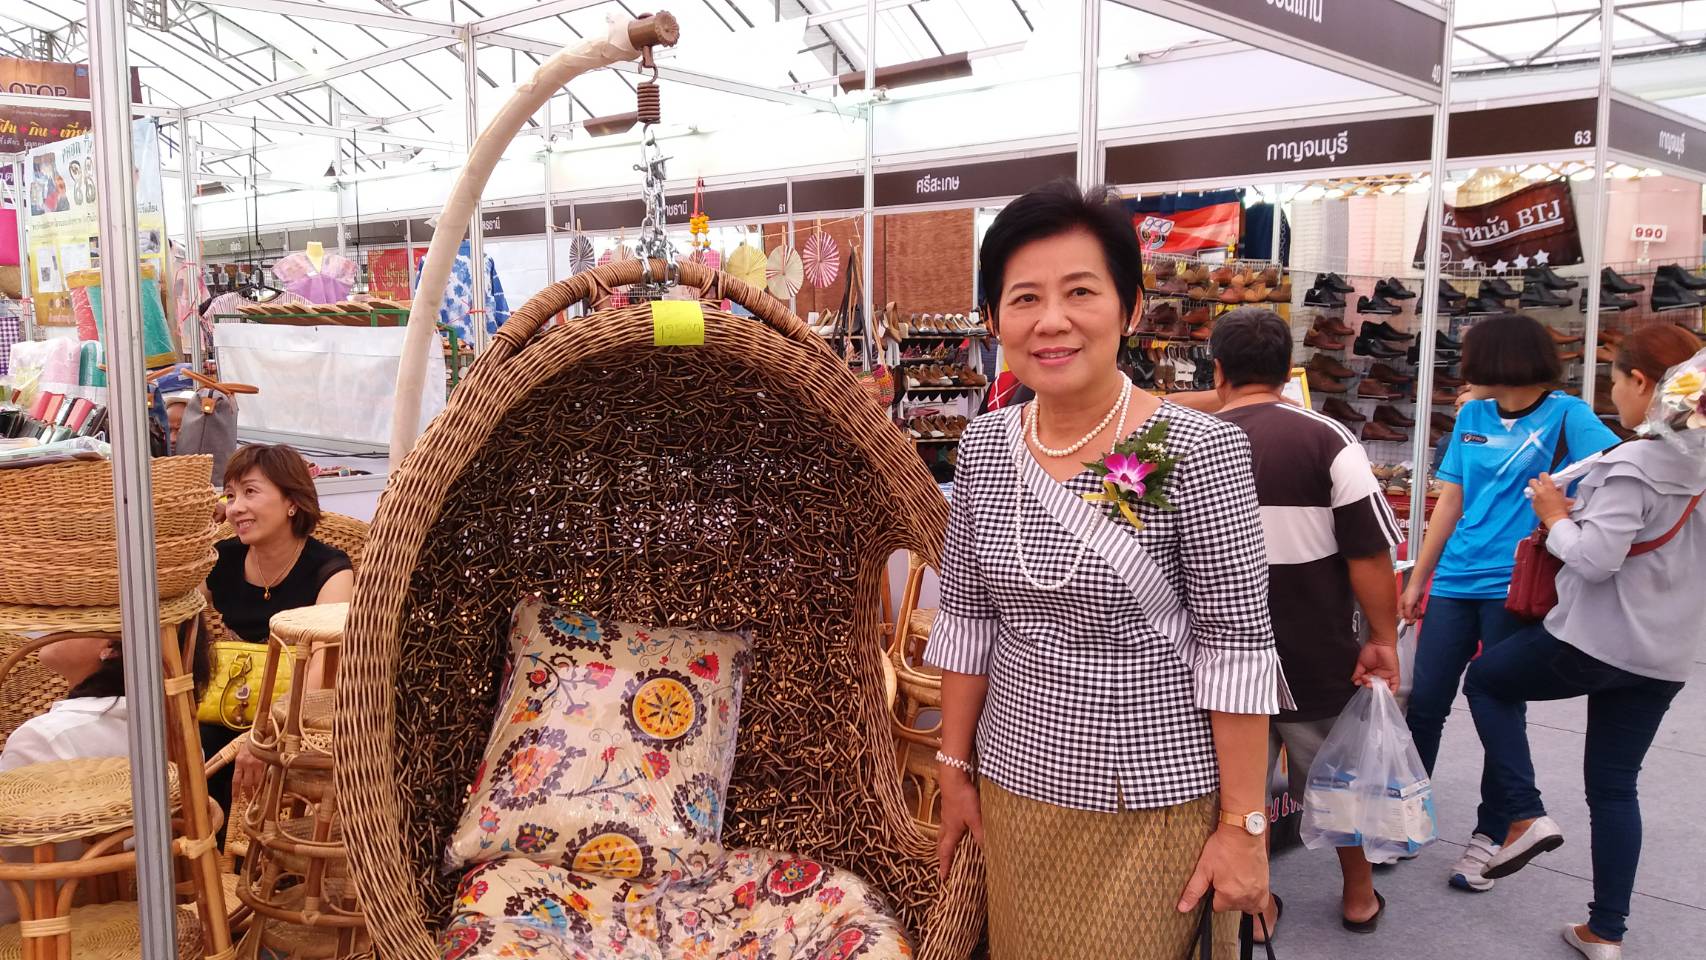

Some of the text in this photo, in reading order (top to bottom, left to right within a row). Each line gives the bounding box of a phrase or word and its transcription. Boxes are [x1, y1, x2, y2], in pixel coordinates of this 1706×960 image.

[1431, 64, 1441, 83] 40
[1266, 130, 1348, 162] กาญจนบุรี
[1574, 130, 1591, 145] 63
[916, 174, 960, 194] ศรีสะเกษ
[778, 203, 786, 213] 61
[1516, 199, 1561, 228] BTJ
